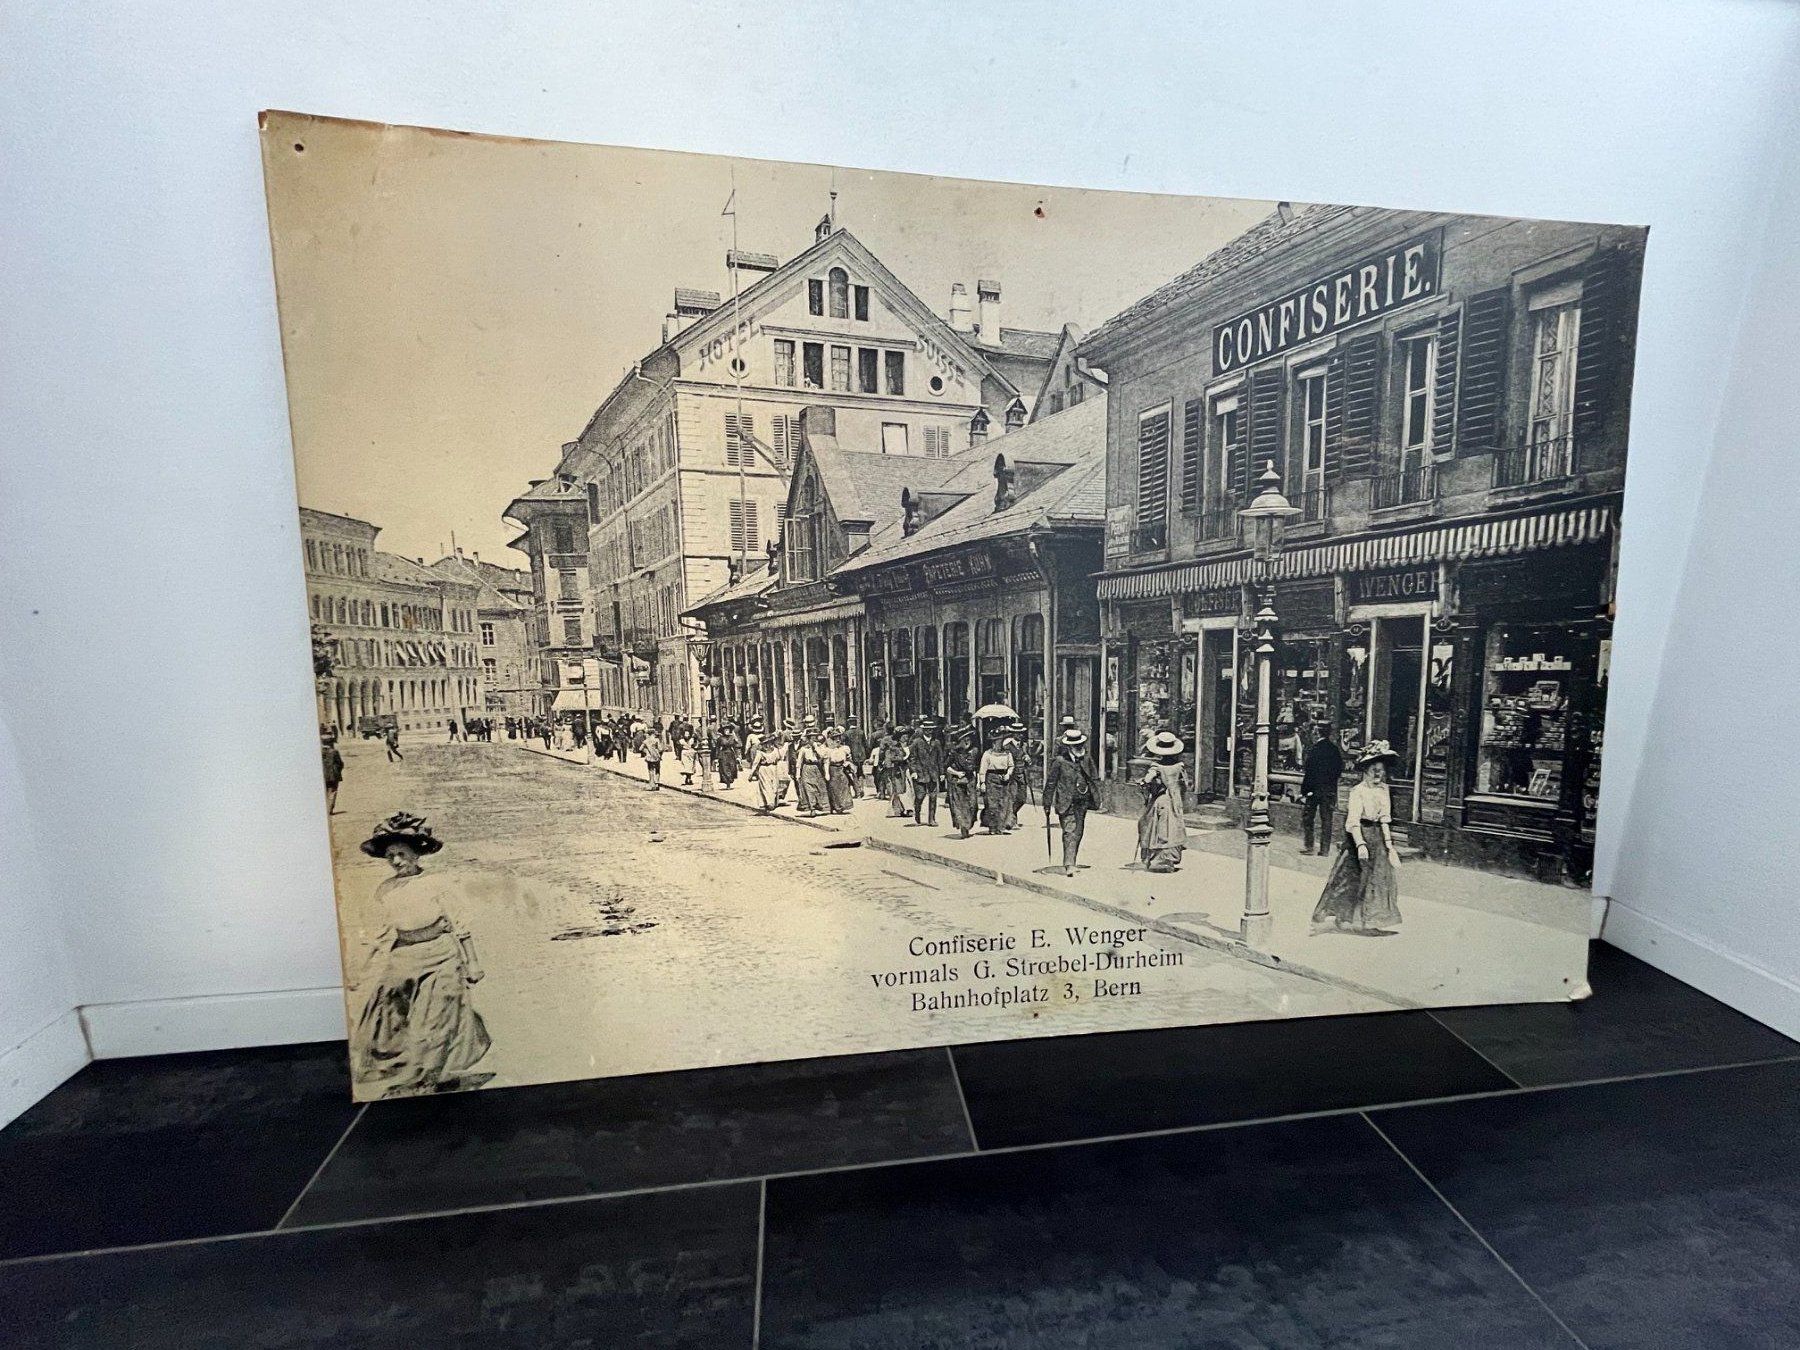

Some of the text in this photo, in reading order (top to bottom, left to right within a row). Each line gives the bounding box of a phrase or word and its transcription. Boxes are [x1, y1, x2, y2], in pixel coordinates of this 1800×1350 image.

[1218, 243, 1431, 371] CONFISERIE.
[908, 926, 1148, 957] Confiserie E. Wenger
[870, 963, 959, 988] vormals
[973, 959, 996, 980] G.
[911, 978, 1142, 1012] Bahnhofplatz 3, Bern
